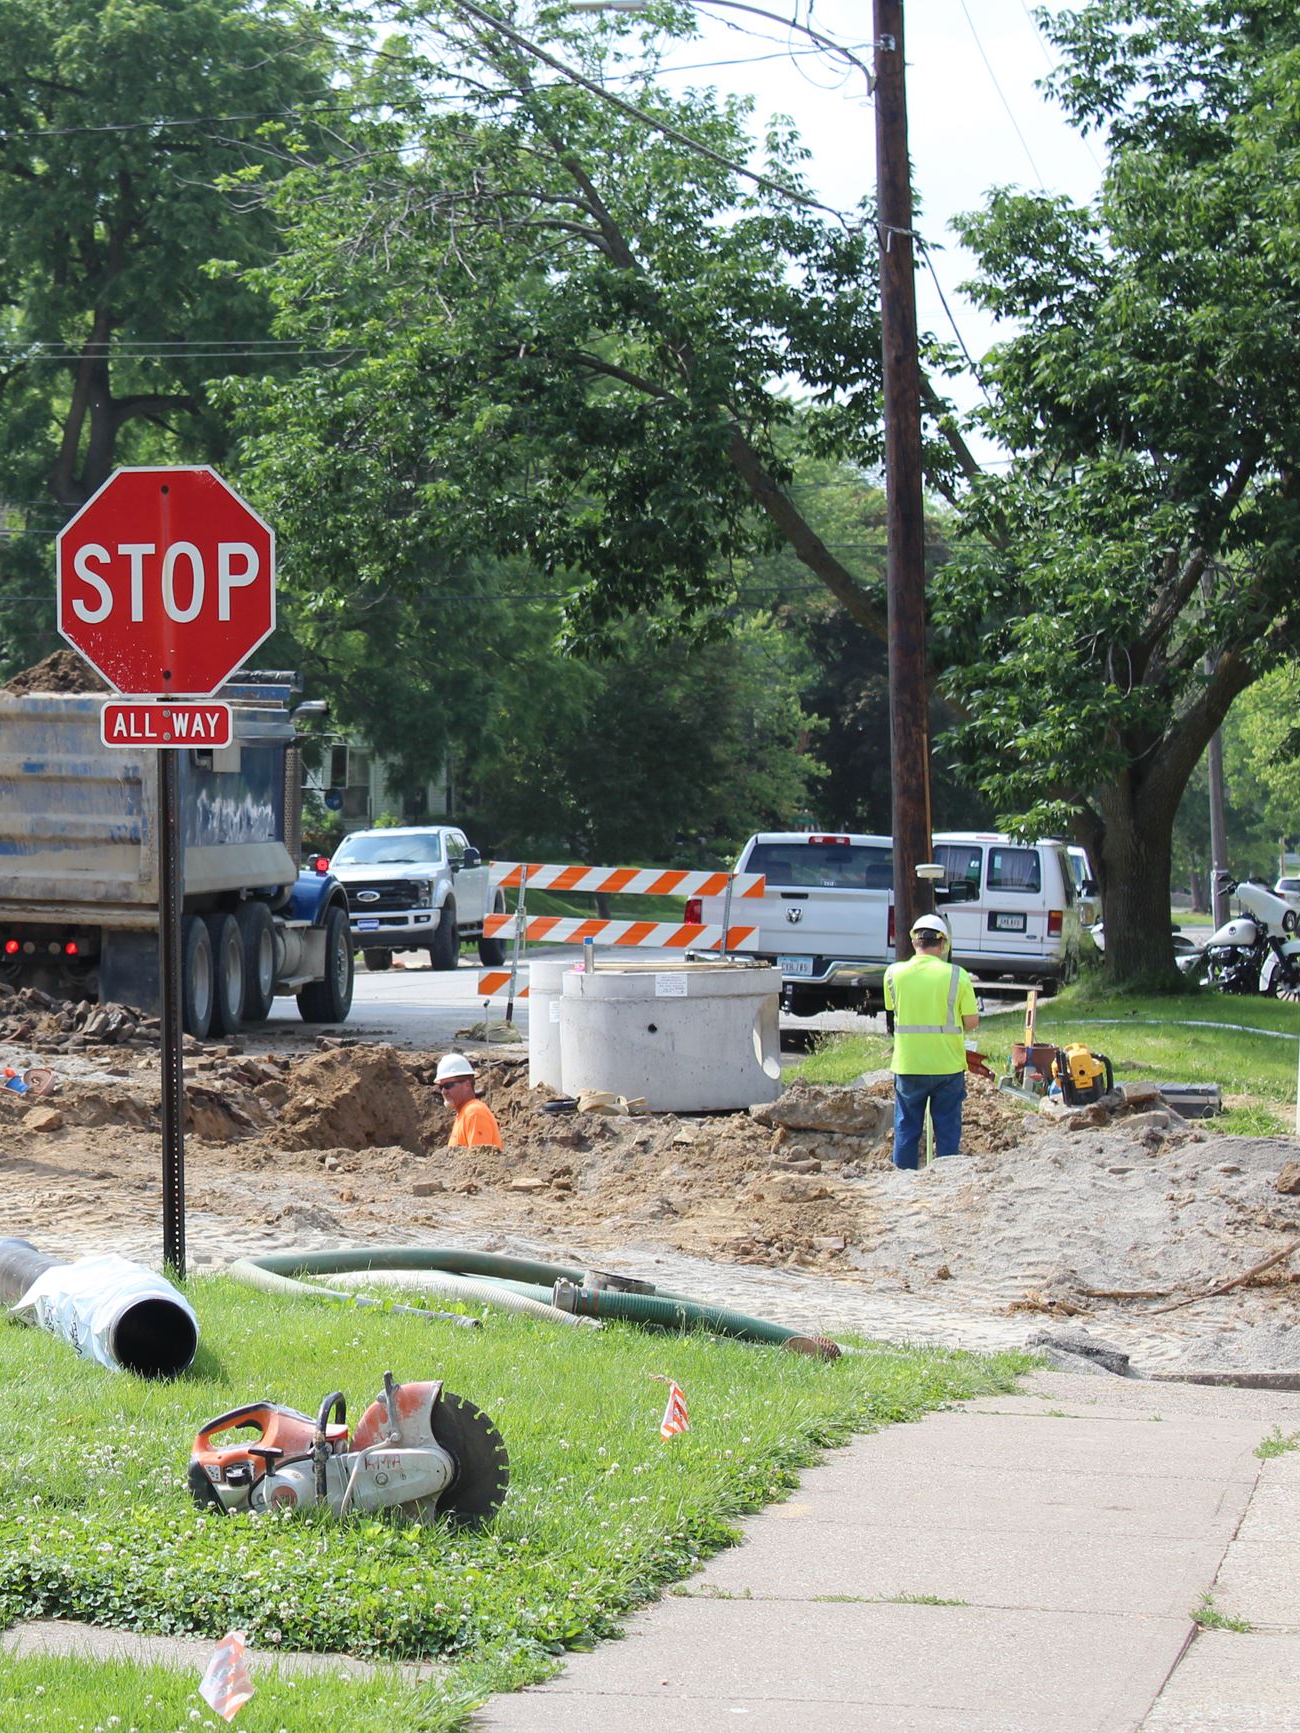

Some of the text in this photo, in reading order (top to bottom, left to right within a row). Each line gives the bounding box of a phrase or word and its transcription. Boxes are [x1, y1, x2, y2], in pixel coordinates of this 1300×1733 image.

[72, 541, 260, 624] STOP
[113, 713, 220, 738] ALL WAY
